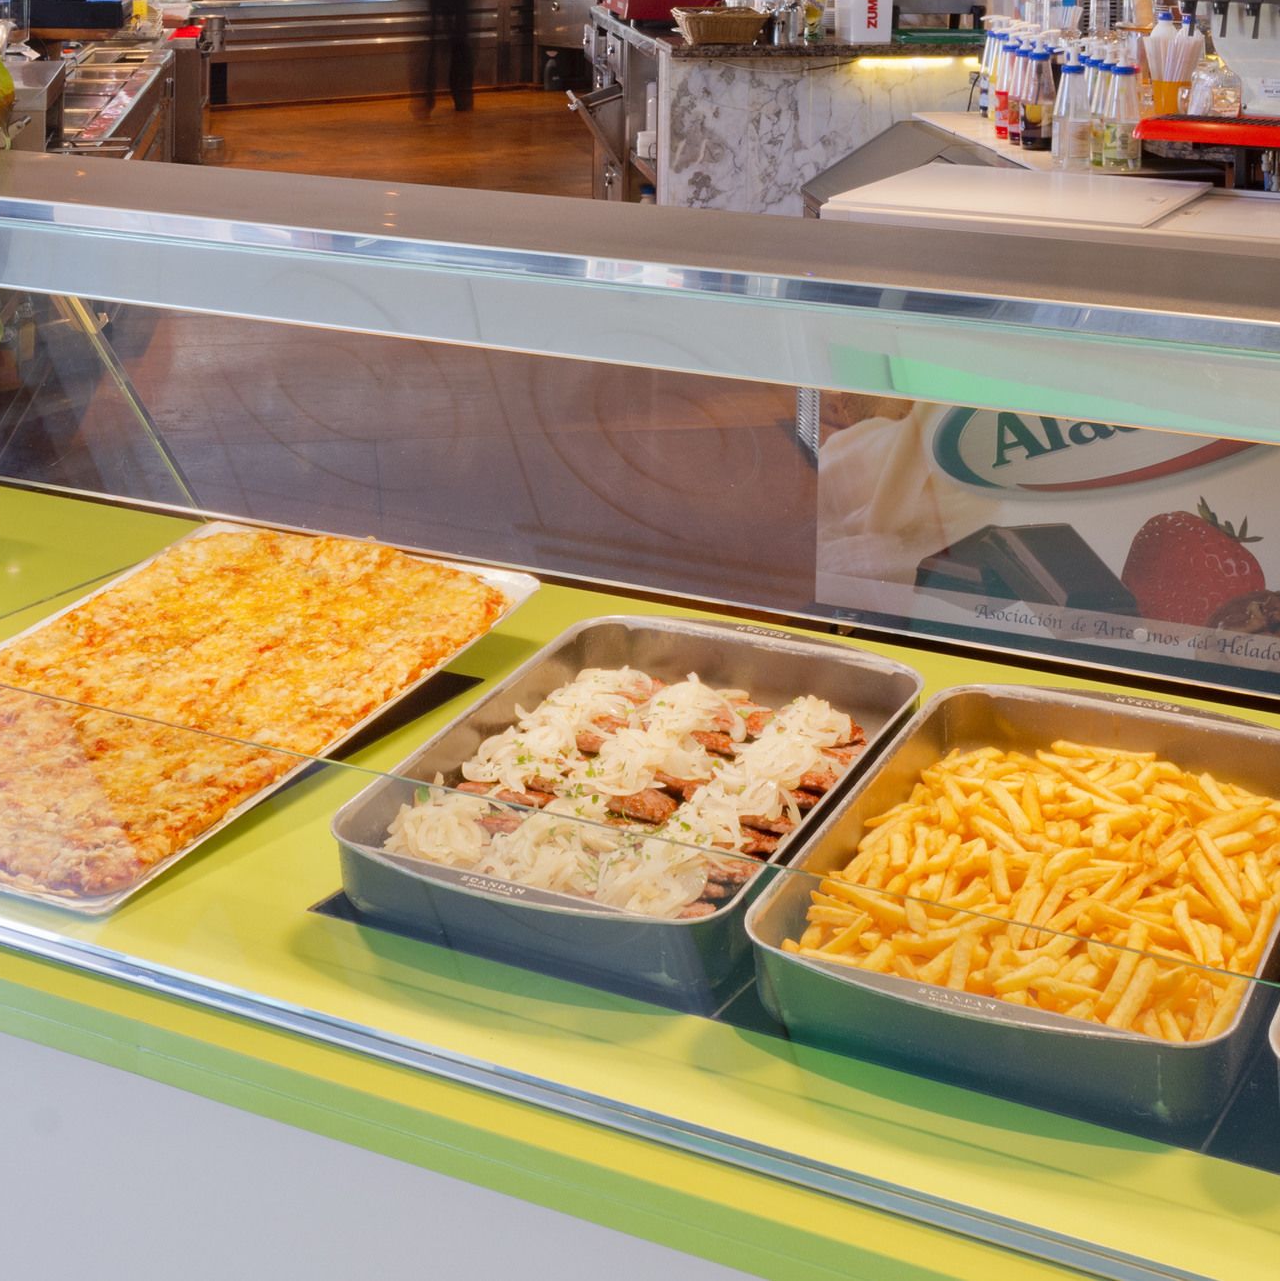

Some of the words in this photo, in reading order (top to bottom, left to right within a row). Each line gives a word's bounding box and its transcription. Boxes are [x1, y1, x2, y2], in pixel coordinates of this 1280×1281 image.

[974, 603, 1063, 630] Asociación
[1070, 620, 1087, 633] de
[1187, 631, 1208, 650] del
[460, 875, 526, 895] SCANPAN
